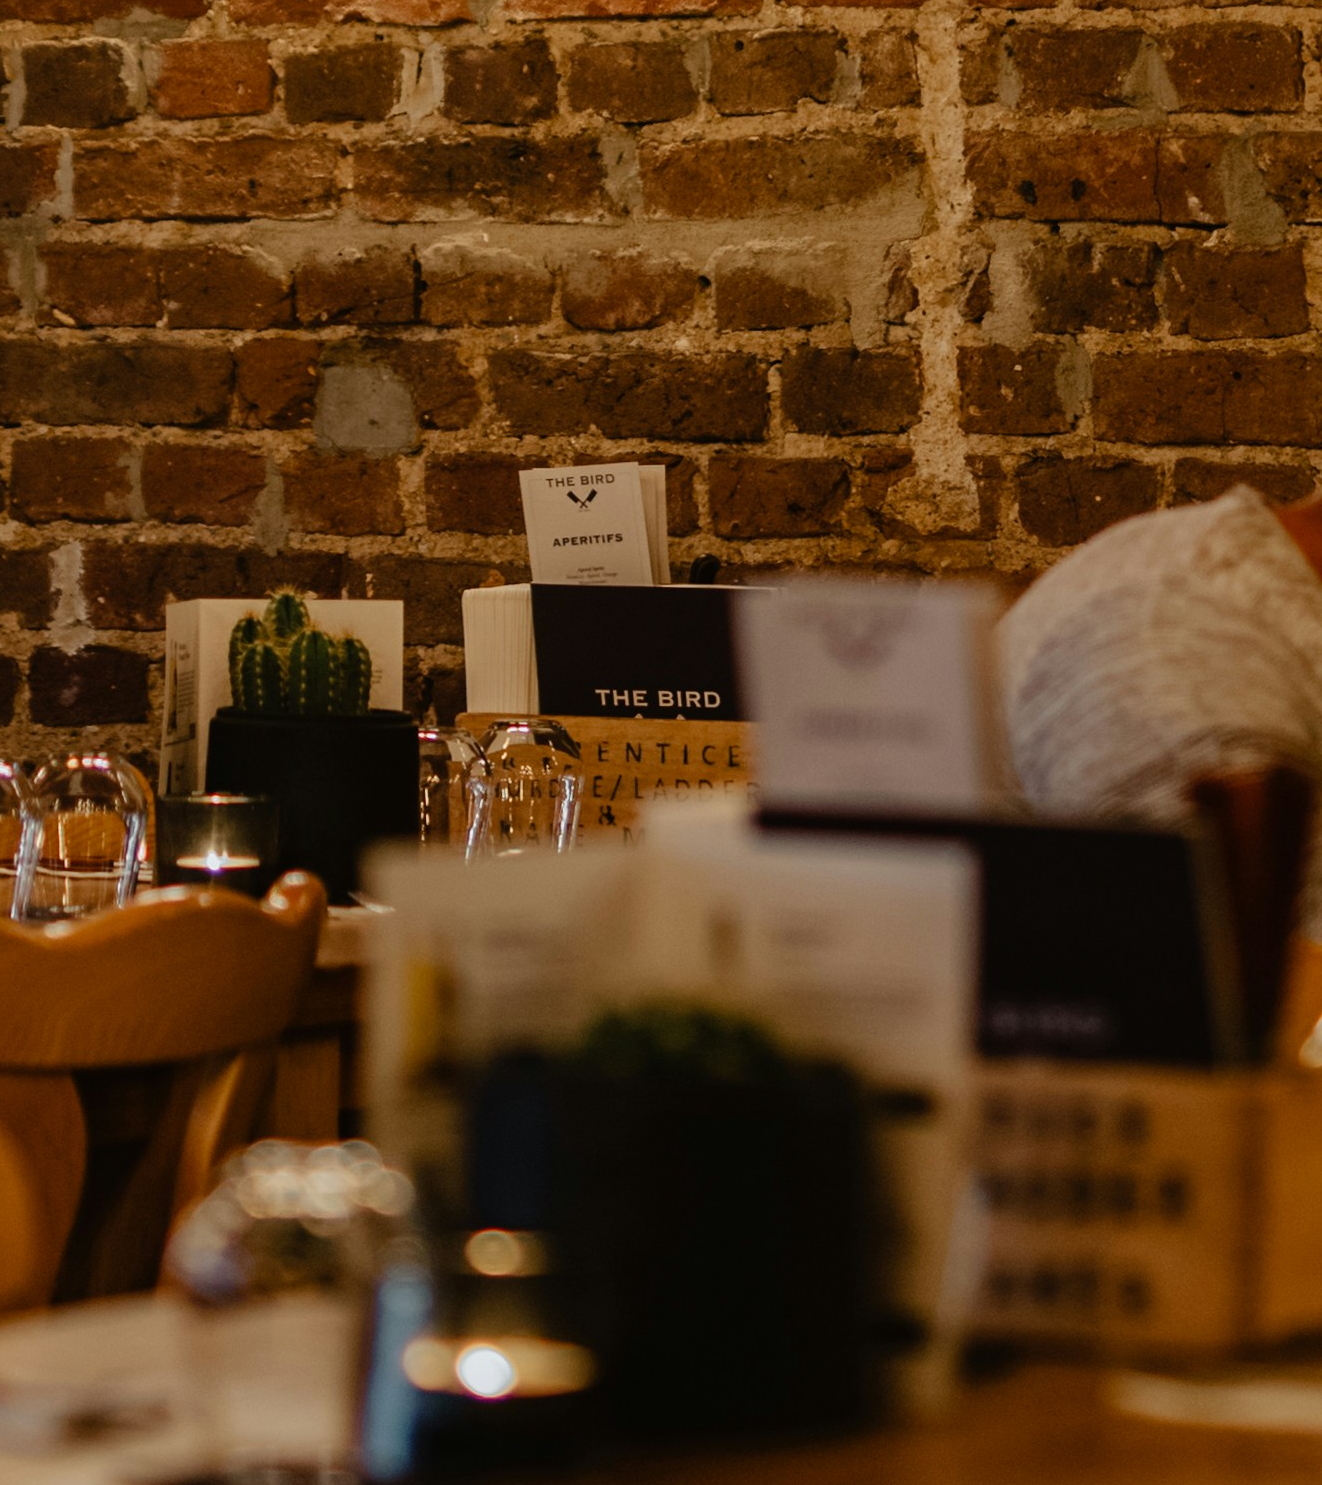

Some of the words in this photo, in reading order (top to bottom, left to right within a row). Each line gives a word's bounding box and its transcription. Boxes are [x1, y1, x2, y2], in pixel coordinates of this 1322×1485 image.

[545, 477, 575, 488] THE
[580, 474, 615, 486] BIRD
[552, 533, 623, 547] APERITIFS
[595, 689, 648, 707] THE
[657, 690, 721, 709] BIRD
